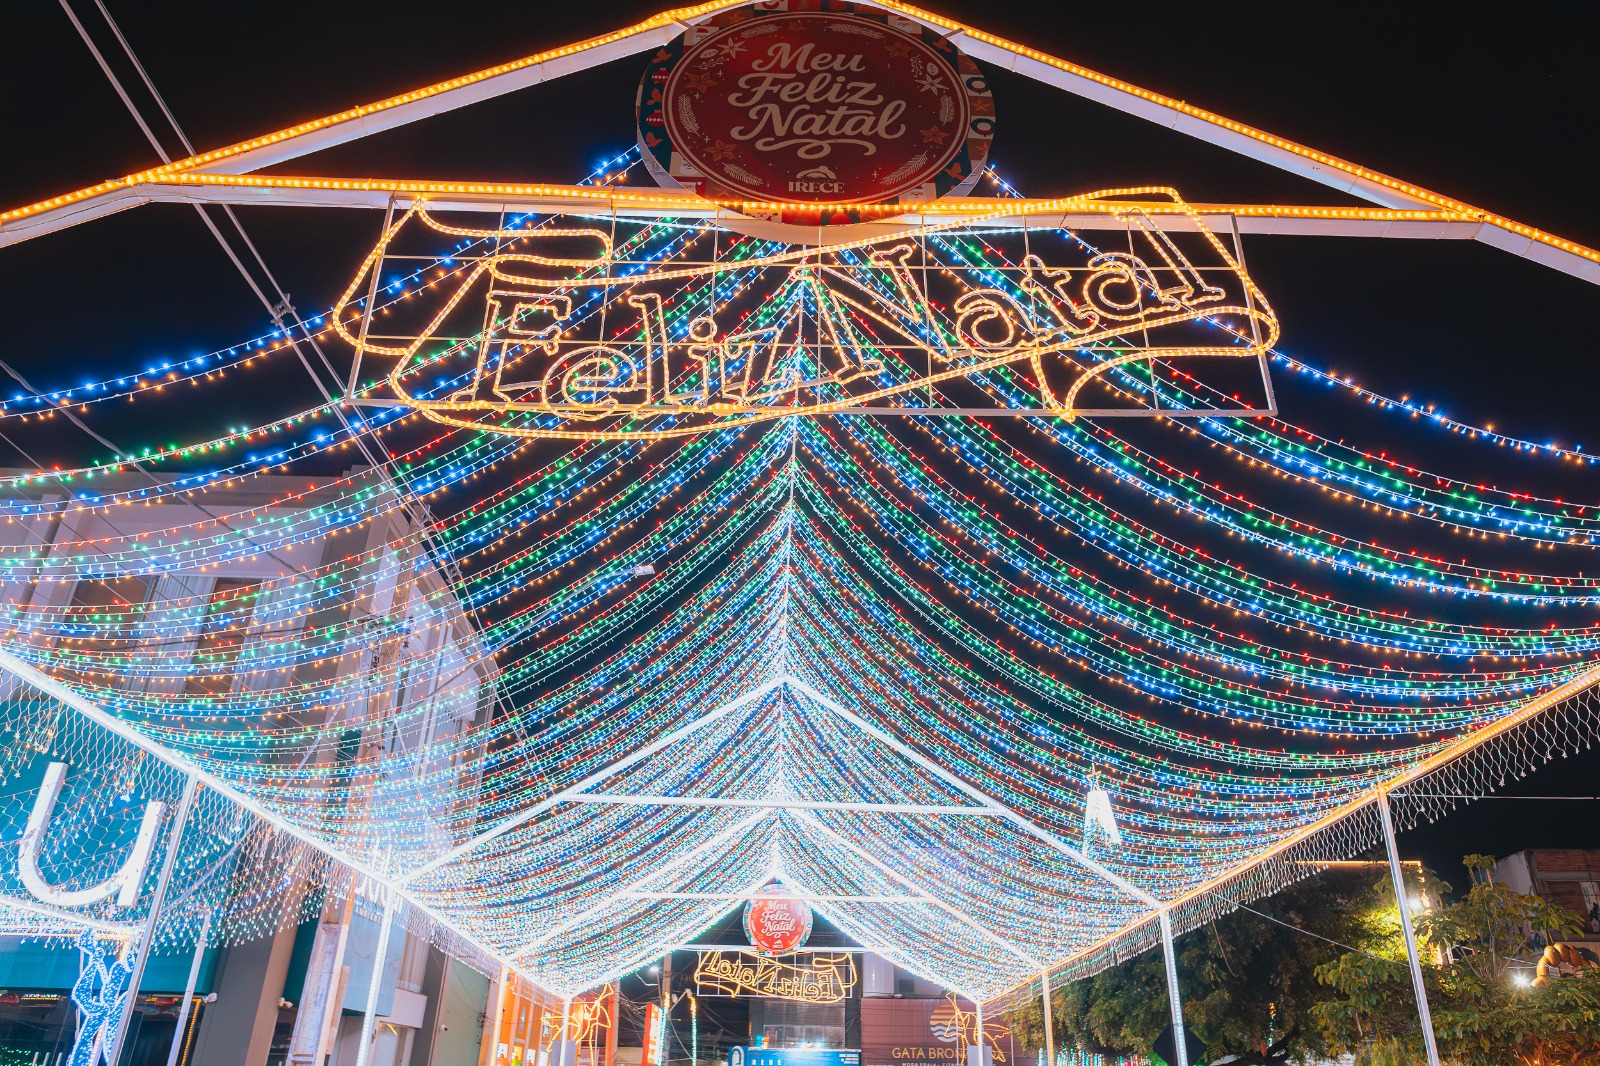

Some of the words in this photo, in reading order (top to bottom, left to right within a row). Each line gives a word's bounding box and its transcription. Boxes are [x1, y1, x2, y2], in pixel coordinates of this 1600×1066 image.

[751, 42, 866, 72] Meu
[728, 72, 883, 107] Feliz
[731, 100, 907, 140] Natal
[452, 288, 799, 420] Feliz
[791, 207, 1226, 384] Natal
[760, 910, 791, 923] Feliz
[763, 900, 788, 911] Meu
[761, 919, 796, 934] Natal
[891, 1047, 926, 1059] GATA
